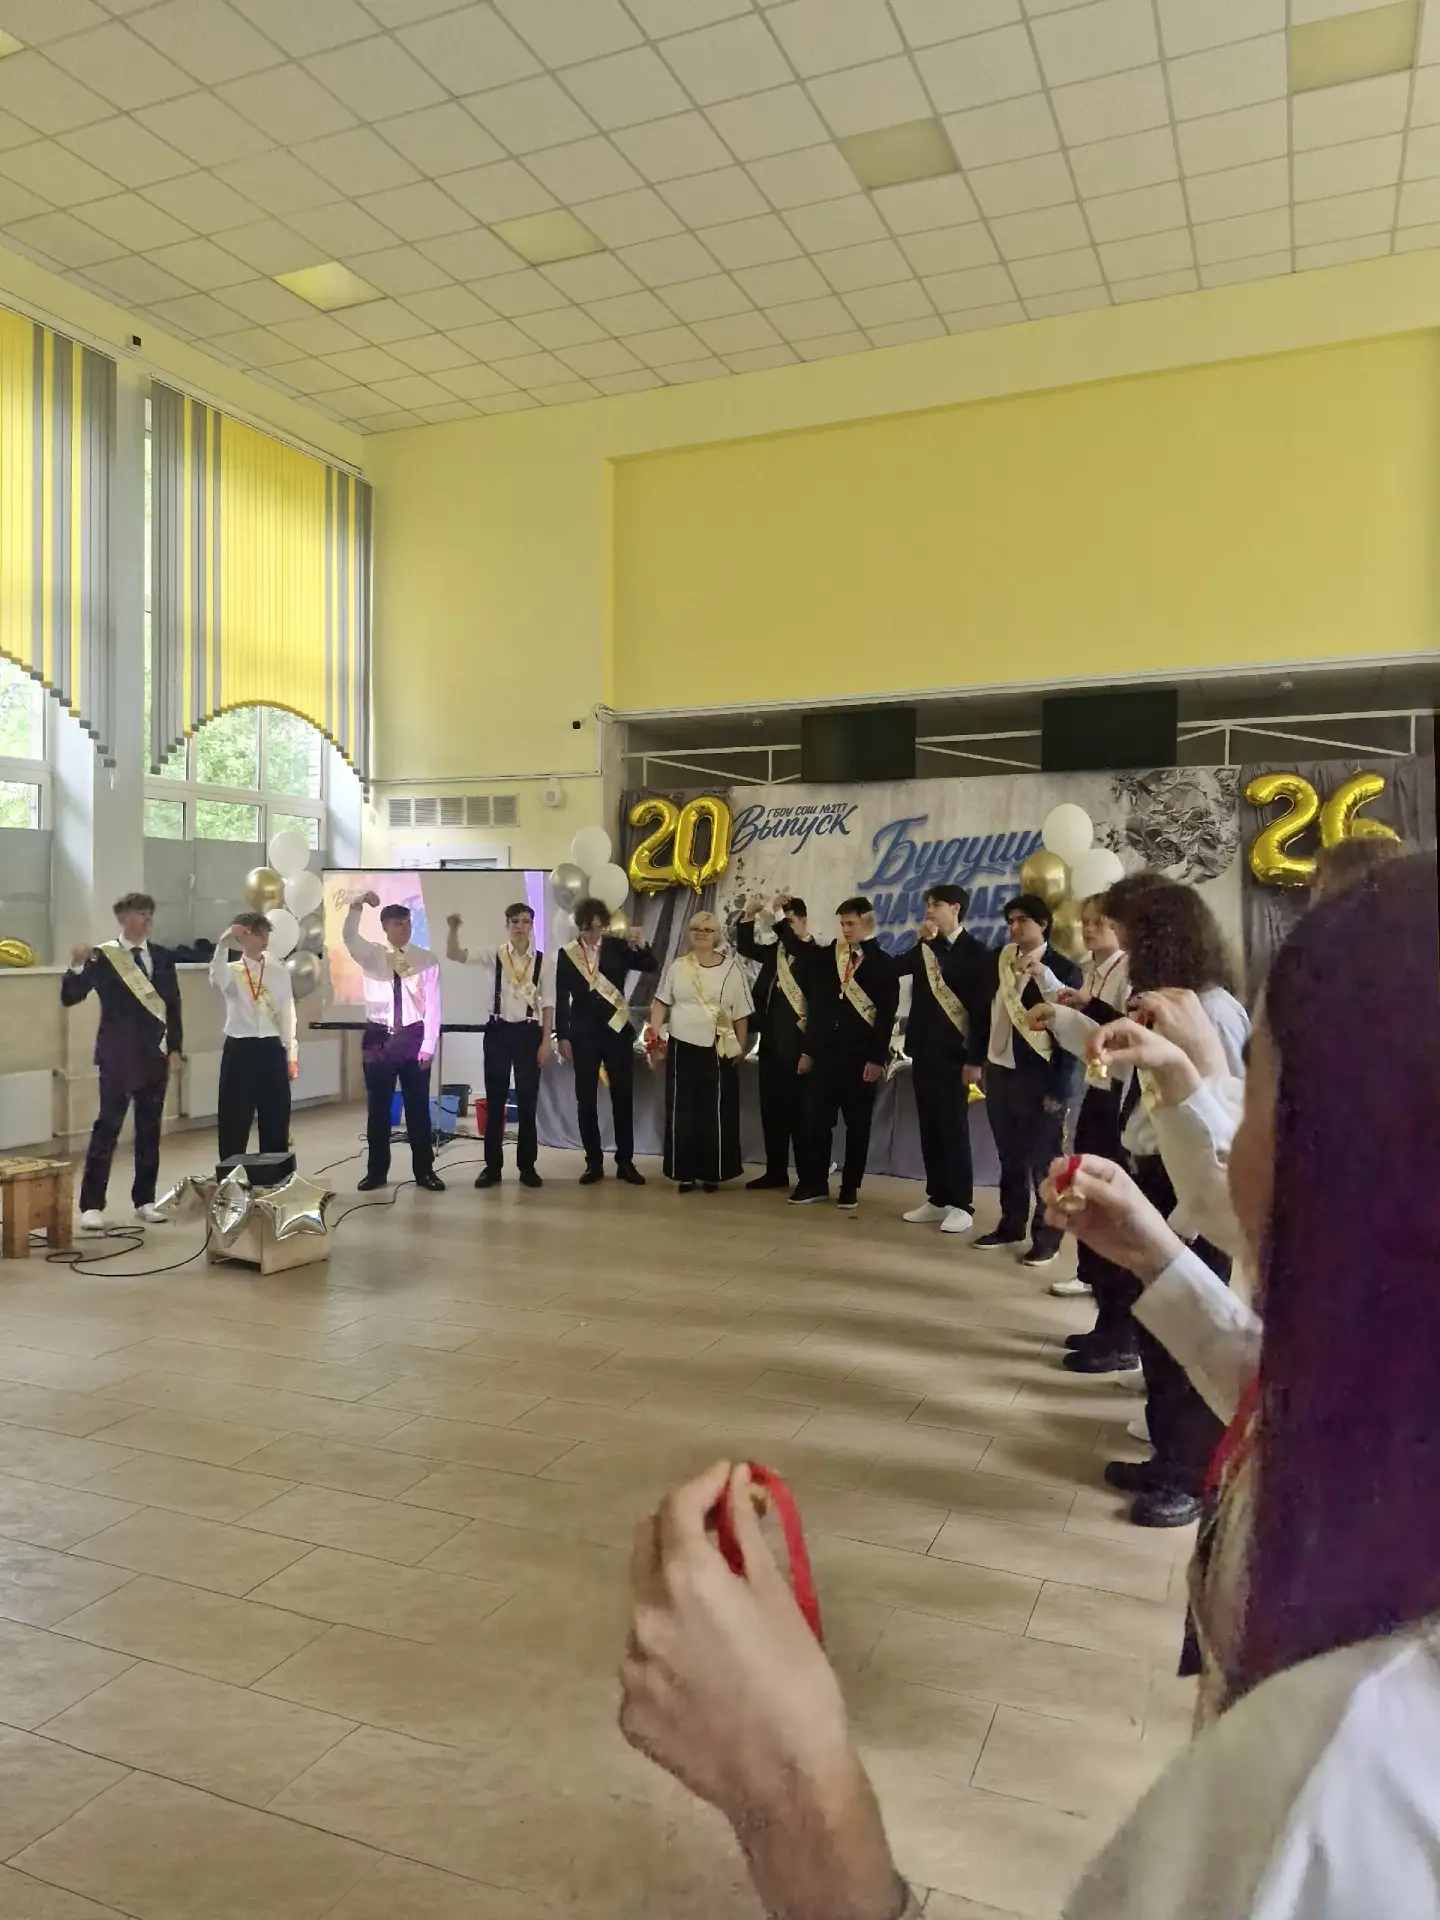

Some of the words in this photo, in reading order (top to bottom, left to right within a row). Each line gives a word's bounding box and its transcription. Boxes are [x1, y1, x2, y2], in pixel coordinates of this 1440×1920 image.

[731, 804, 858, 854] Выпуск
[767, 807, 793, 818] ГБОУ
[795, 805, 817, 816] СОШ
[628, 796, 733, 895] 20
